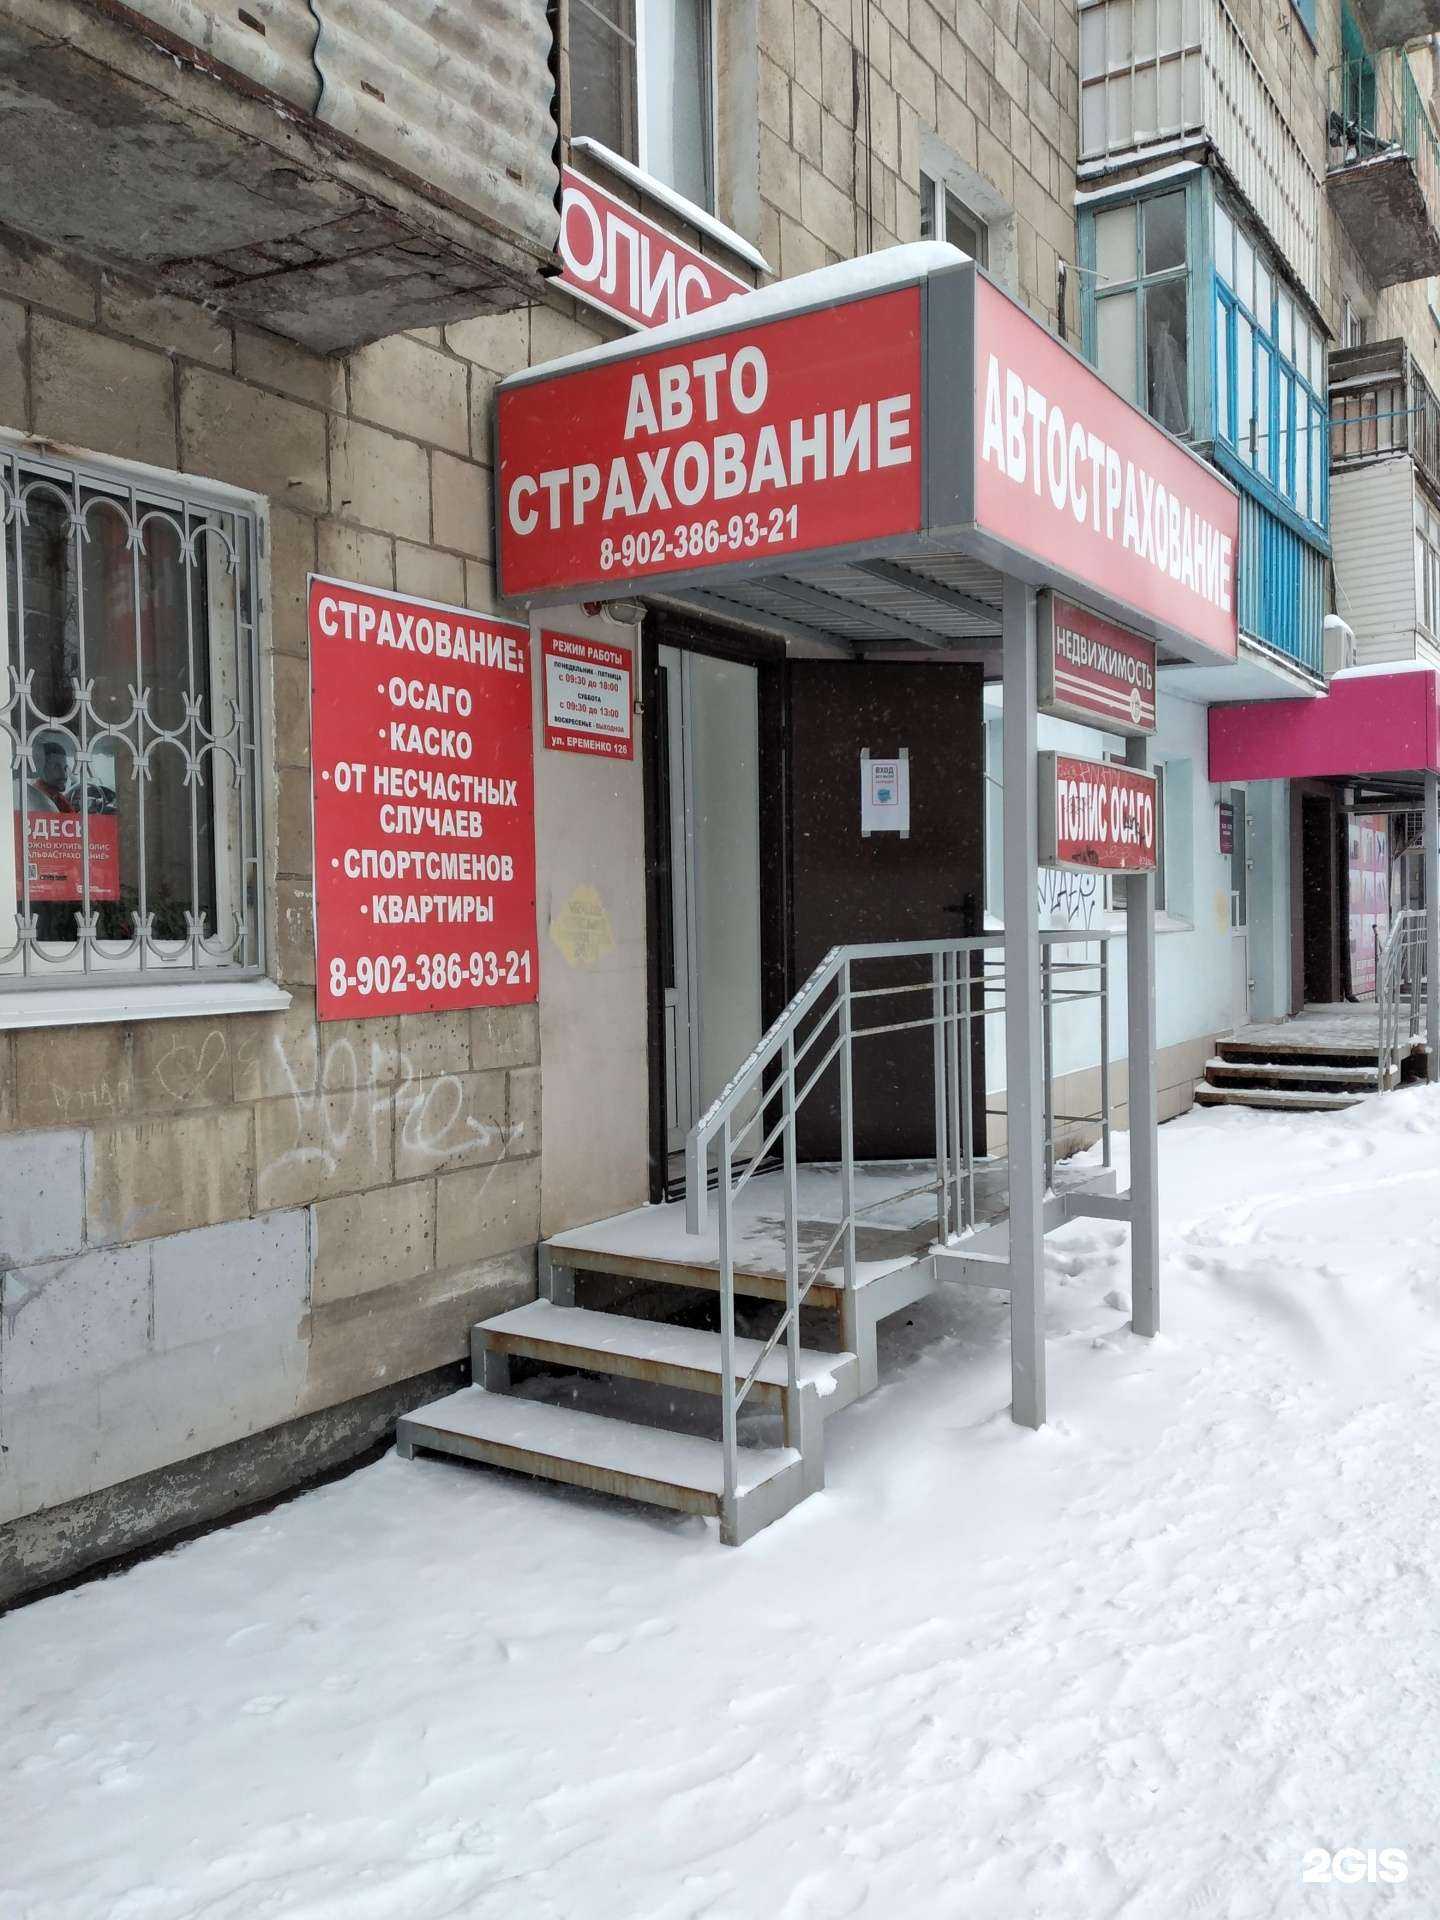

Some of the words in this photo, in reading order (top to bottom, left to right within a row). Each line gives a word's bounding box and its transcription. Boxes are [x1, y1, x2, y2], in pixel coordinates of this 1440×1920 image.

[624, 345, 769, 440] АВТО
[508, 394, 912, 536] СТРАХОВАНИЕ
[982, 352, 1232, 613] АВТОСТРАХОВАНИЕ
[600, 504, 799, 571] 8-902-386-93-21
[318, 597, 525, 673] СТРАХОВАНИЕ:
[552, 639, 585, 657] РЕЖИМ
[588, 645, 622, 665] РАБОТЫ
[554, 661, 593, 676] ПОНЕДЕЛЬНИК
[597, 671, 622, 681] ПЯТНИЦА
[1056, 626, 1153, 691] НЕДВИЖИМОСТЬ
[388, 676, 473, 717] ОСАГО
[565, 674, 586, 686] 09:30
[588, 681, 597, 689] до
[599, 681, 619, 692] 18:00
[578, 692, 602, 702] СУББОТА
[554, 715, 593, 728] ВОСКРЕСЕНЬЕ
[566, 701, 587, 713] 09:30
[588, 707, 598, 716] до
[600, 707, 619, 719] 13:00
[390, 722, 473, 760] КАСКО
[551, 736, 565, 747] ул.
[567, 736, 612, 752] ЕРЕМЕНКО
[334, 762, 367, 792] ОТ
[373, 766, 518, 806] НЕСЧАСТНЫХ
[380, 804, 484, 838] СЛУЧАЕВ
[1058, 780, 1108, 843] ПОЛИС
[1110, 786, 1153, 849] ОСАГО
[28, 841, 52, 850] ОЖНО
[344, 849, 514, 882] СПОРТСМЕНОВ
[372, 895, 494, 924] КВАРТИРЫ
[329, 950, 532, 997] 8-902-386-93-21
